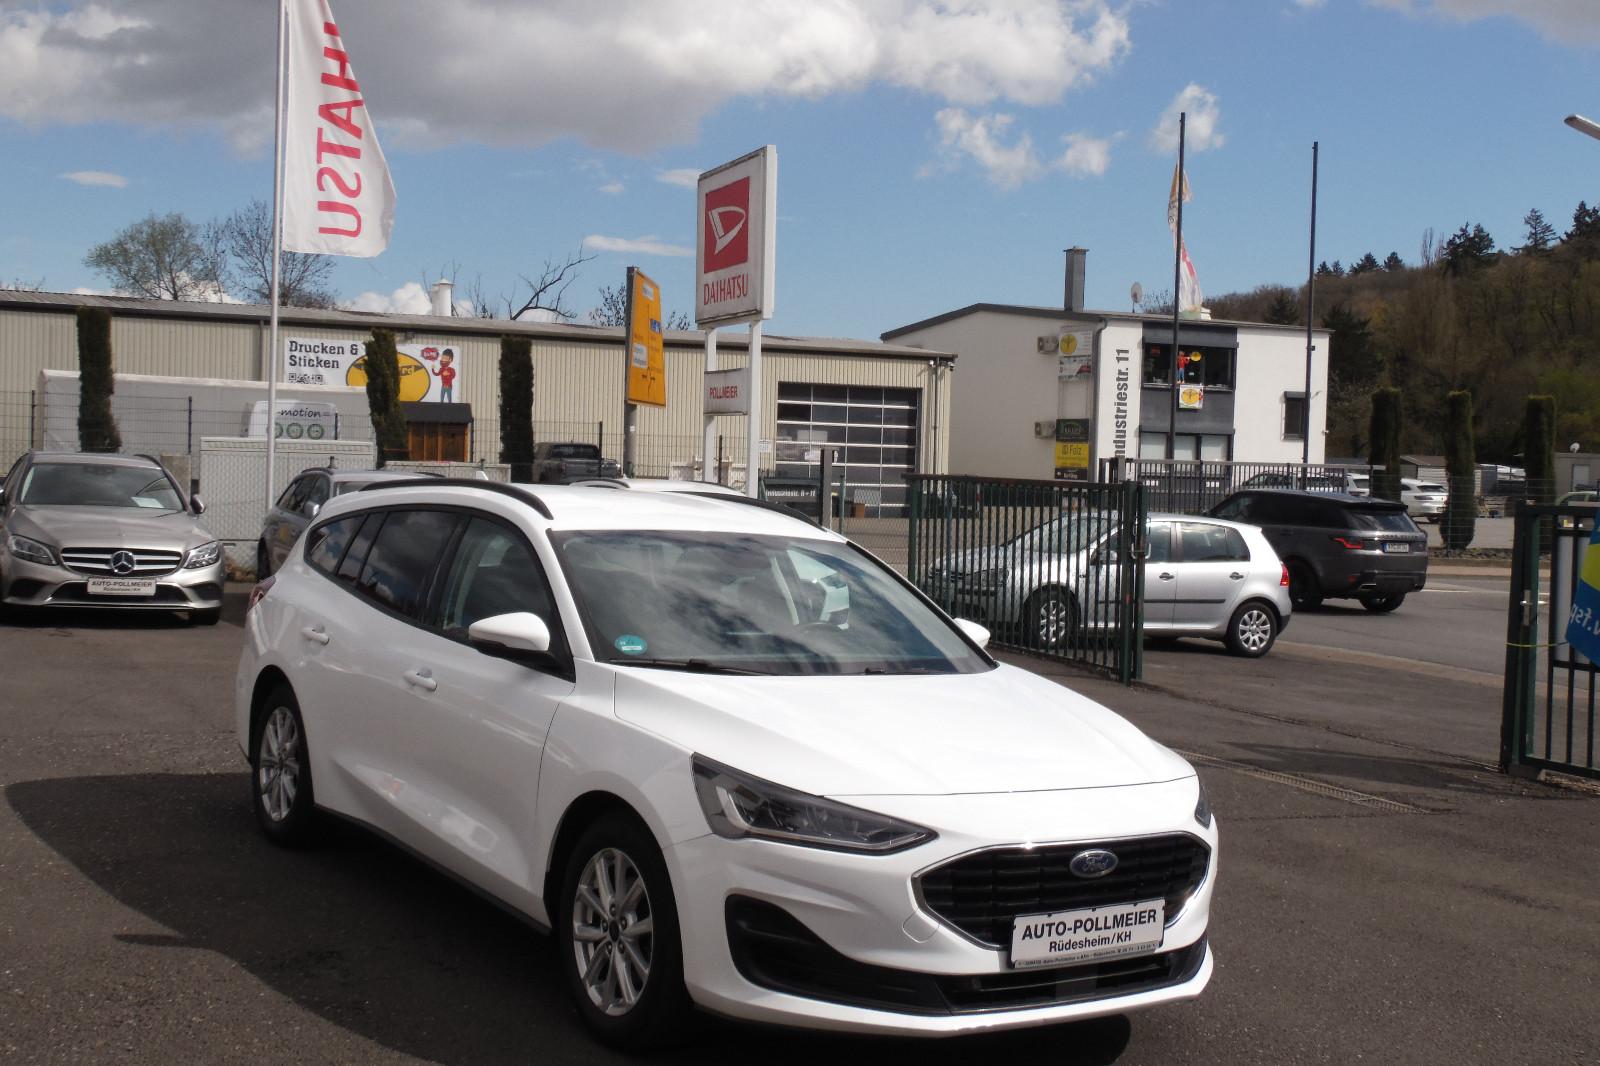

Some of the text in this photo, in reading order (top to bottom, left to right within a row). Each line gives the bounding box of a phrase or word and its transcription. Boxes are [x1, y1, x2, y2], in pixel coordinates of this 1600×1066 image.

[703, 271, 749, 306] DAIHATSU
[289, 340, 359, 355] Drucken &
[289, 354, 340, 369] Sticken
[709, 385, 738, 400] POLLMEIER
[1113, 349, 1130, 458] ndustriestr. 11
[1021, 908, 1157, 940] AUTO-POLLMEIER
[1049, 931, 1132, 953] Rüdesheim/KH
